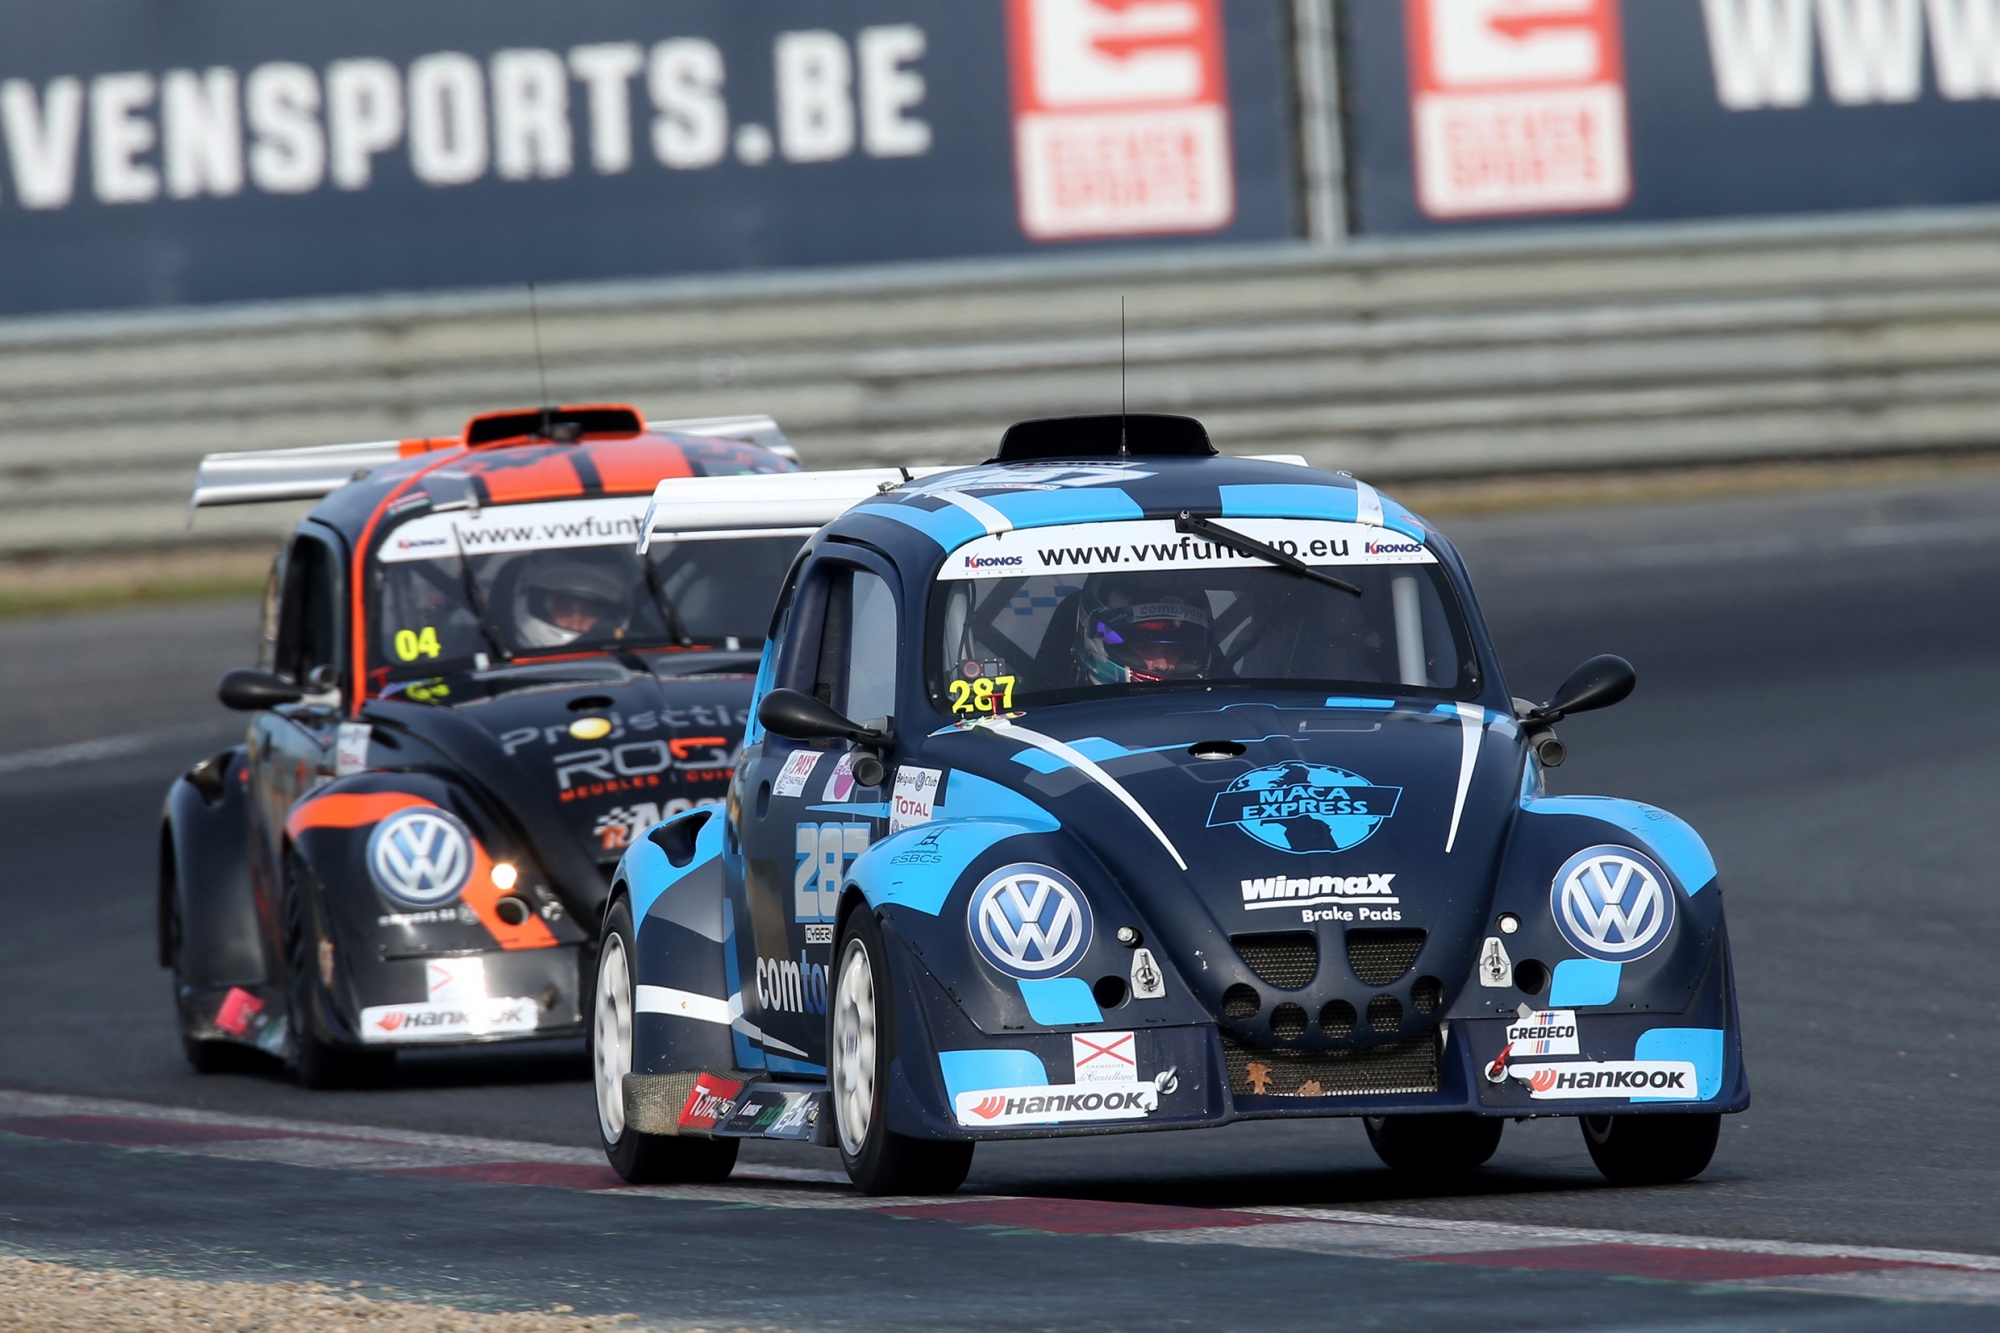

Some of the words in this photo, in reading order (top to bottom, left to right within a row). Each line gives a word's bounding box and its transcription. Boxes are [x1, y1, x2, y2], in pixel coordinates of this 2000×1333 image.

[461, 515, 643, 546] www.vwfun
[1365, 538, 1422, 554] KRONOS
[965, 552, 1023, 568] KRONOS
[395, 626, 441, 662] 04
[949, 675, 1015, 714] 287
[559, 774, 660, 801] MEUBLES
[896, 772, 916, 787] Belgian
[924, 775, 938, 787] Club
[1259, 785, 1351, 803] MACA
[895, 795, 929, 817] TOTAL
[1242, 798, 1368, 820] EXPRESS
[890, 853, 943, 865] ESBCS
[1301, 906, 1354, 923] Brake
[1358, 906, 1402, 922] Pads
[756, 949, 830, 1015] comto
[1509, 1024, 1575, 1040] CREDECO
